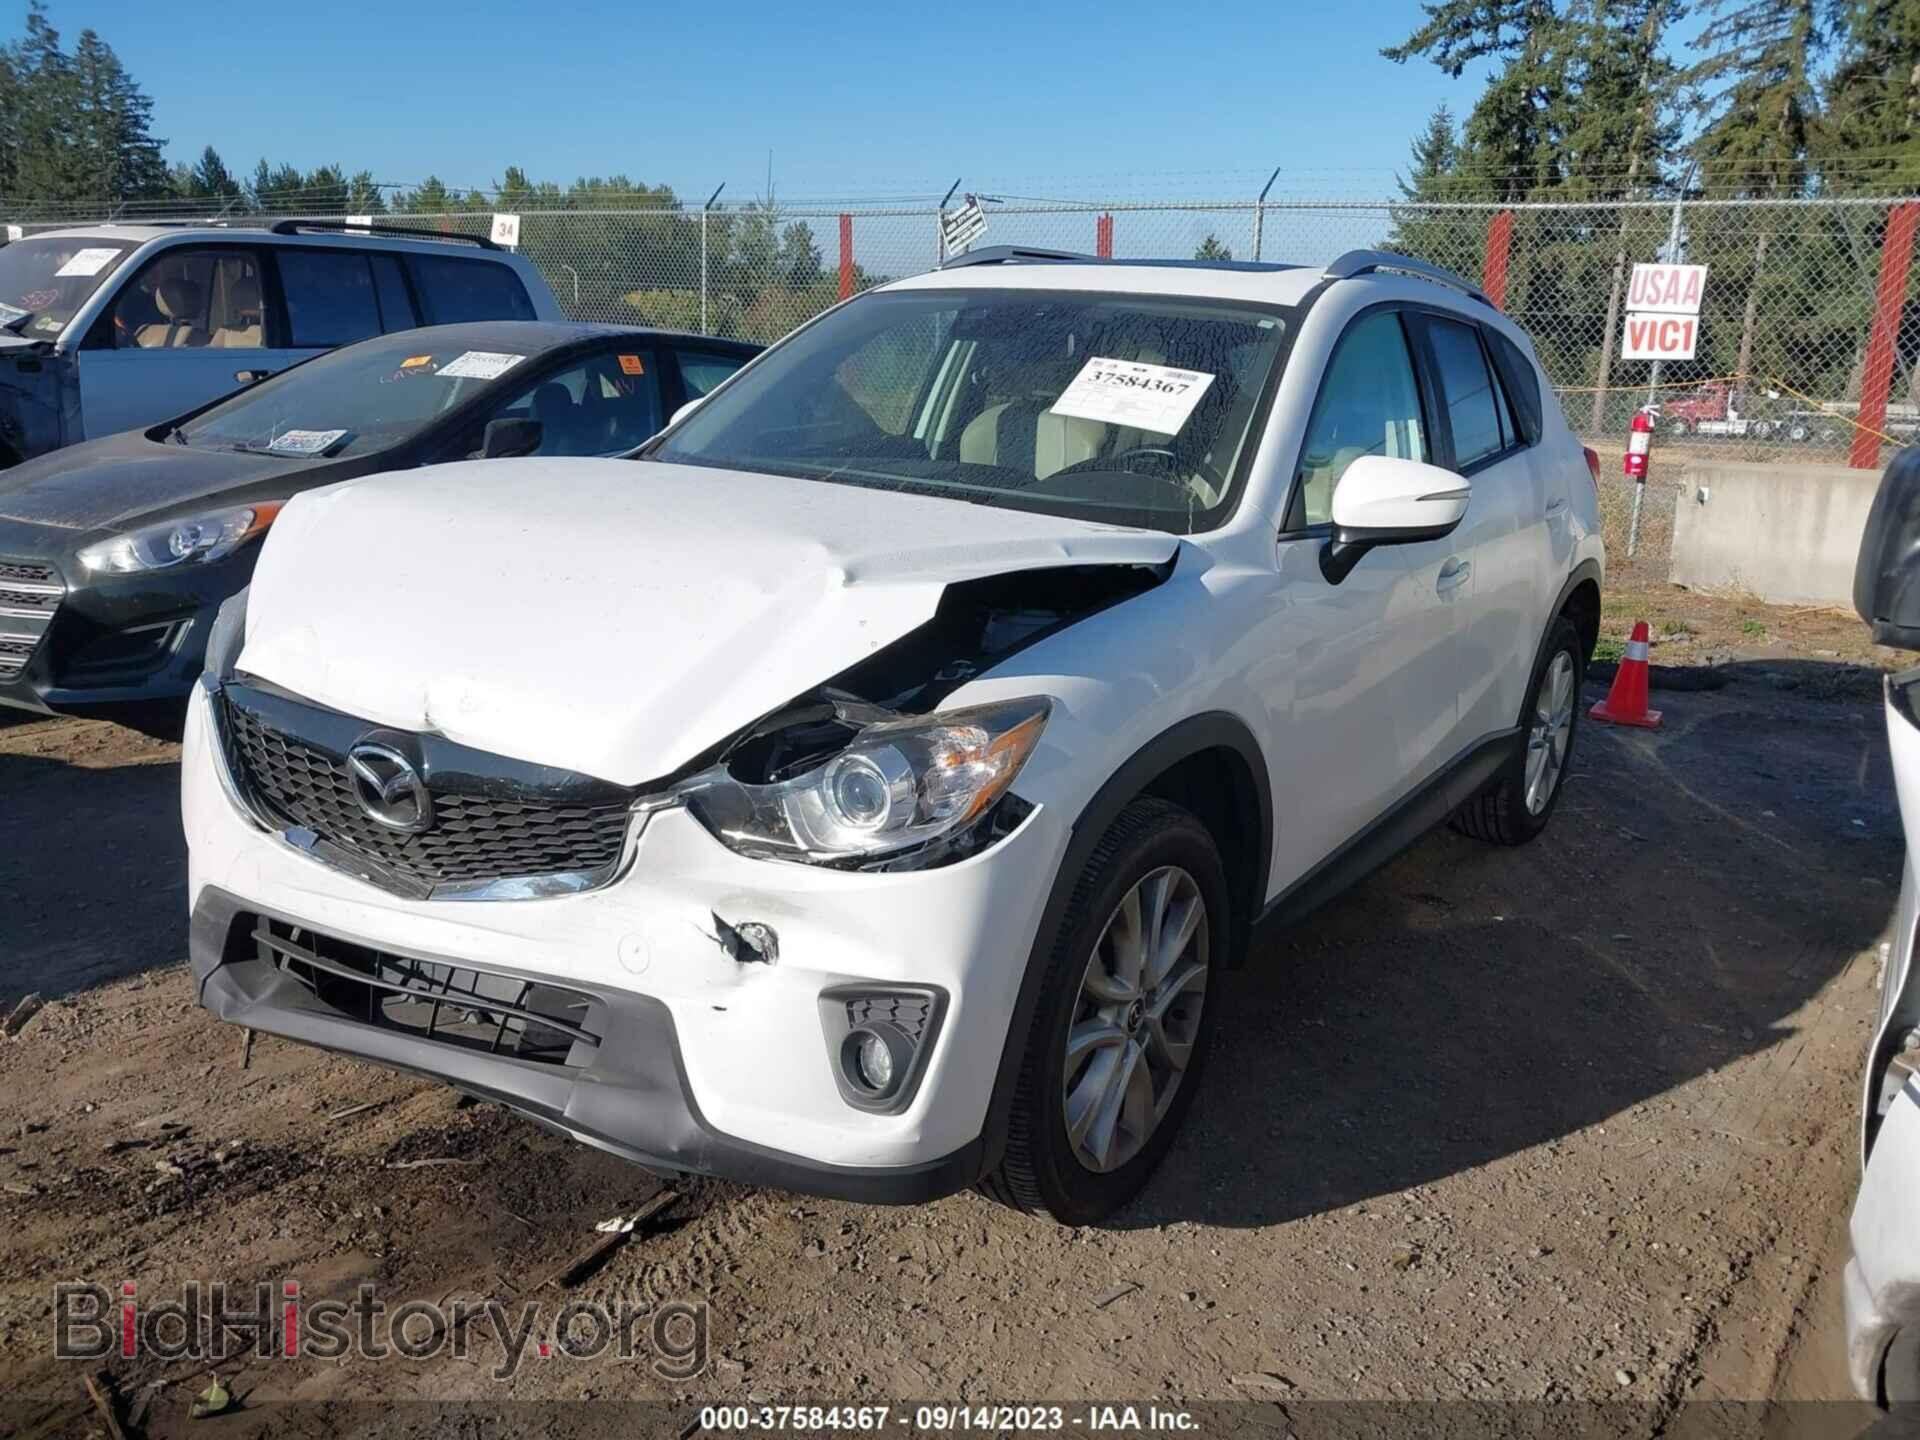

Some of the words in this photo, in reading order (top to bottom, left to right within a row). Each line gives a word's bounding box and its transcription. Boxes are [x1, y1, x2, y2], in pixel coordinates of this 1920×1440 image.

[499, 223, 513, 238] 34
[1630, 270, 1700, 305] USAA
[1629, 319, 1693, 352] VIC1
[1088, 371, 1190, 396] 37584367
